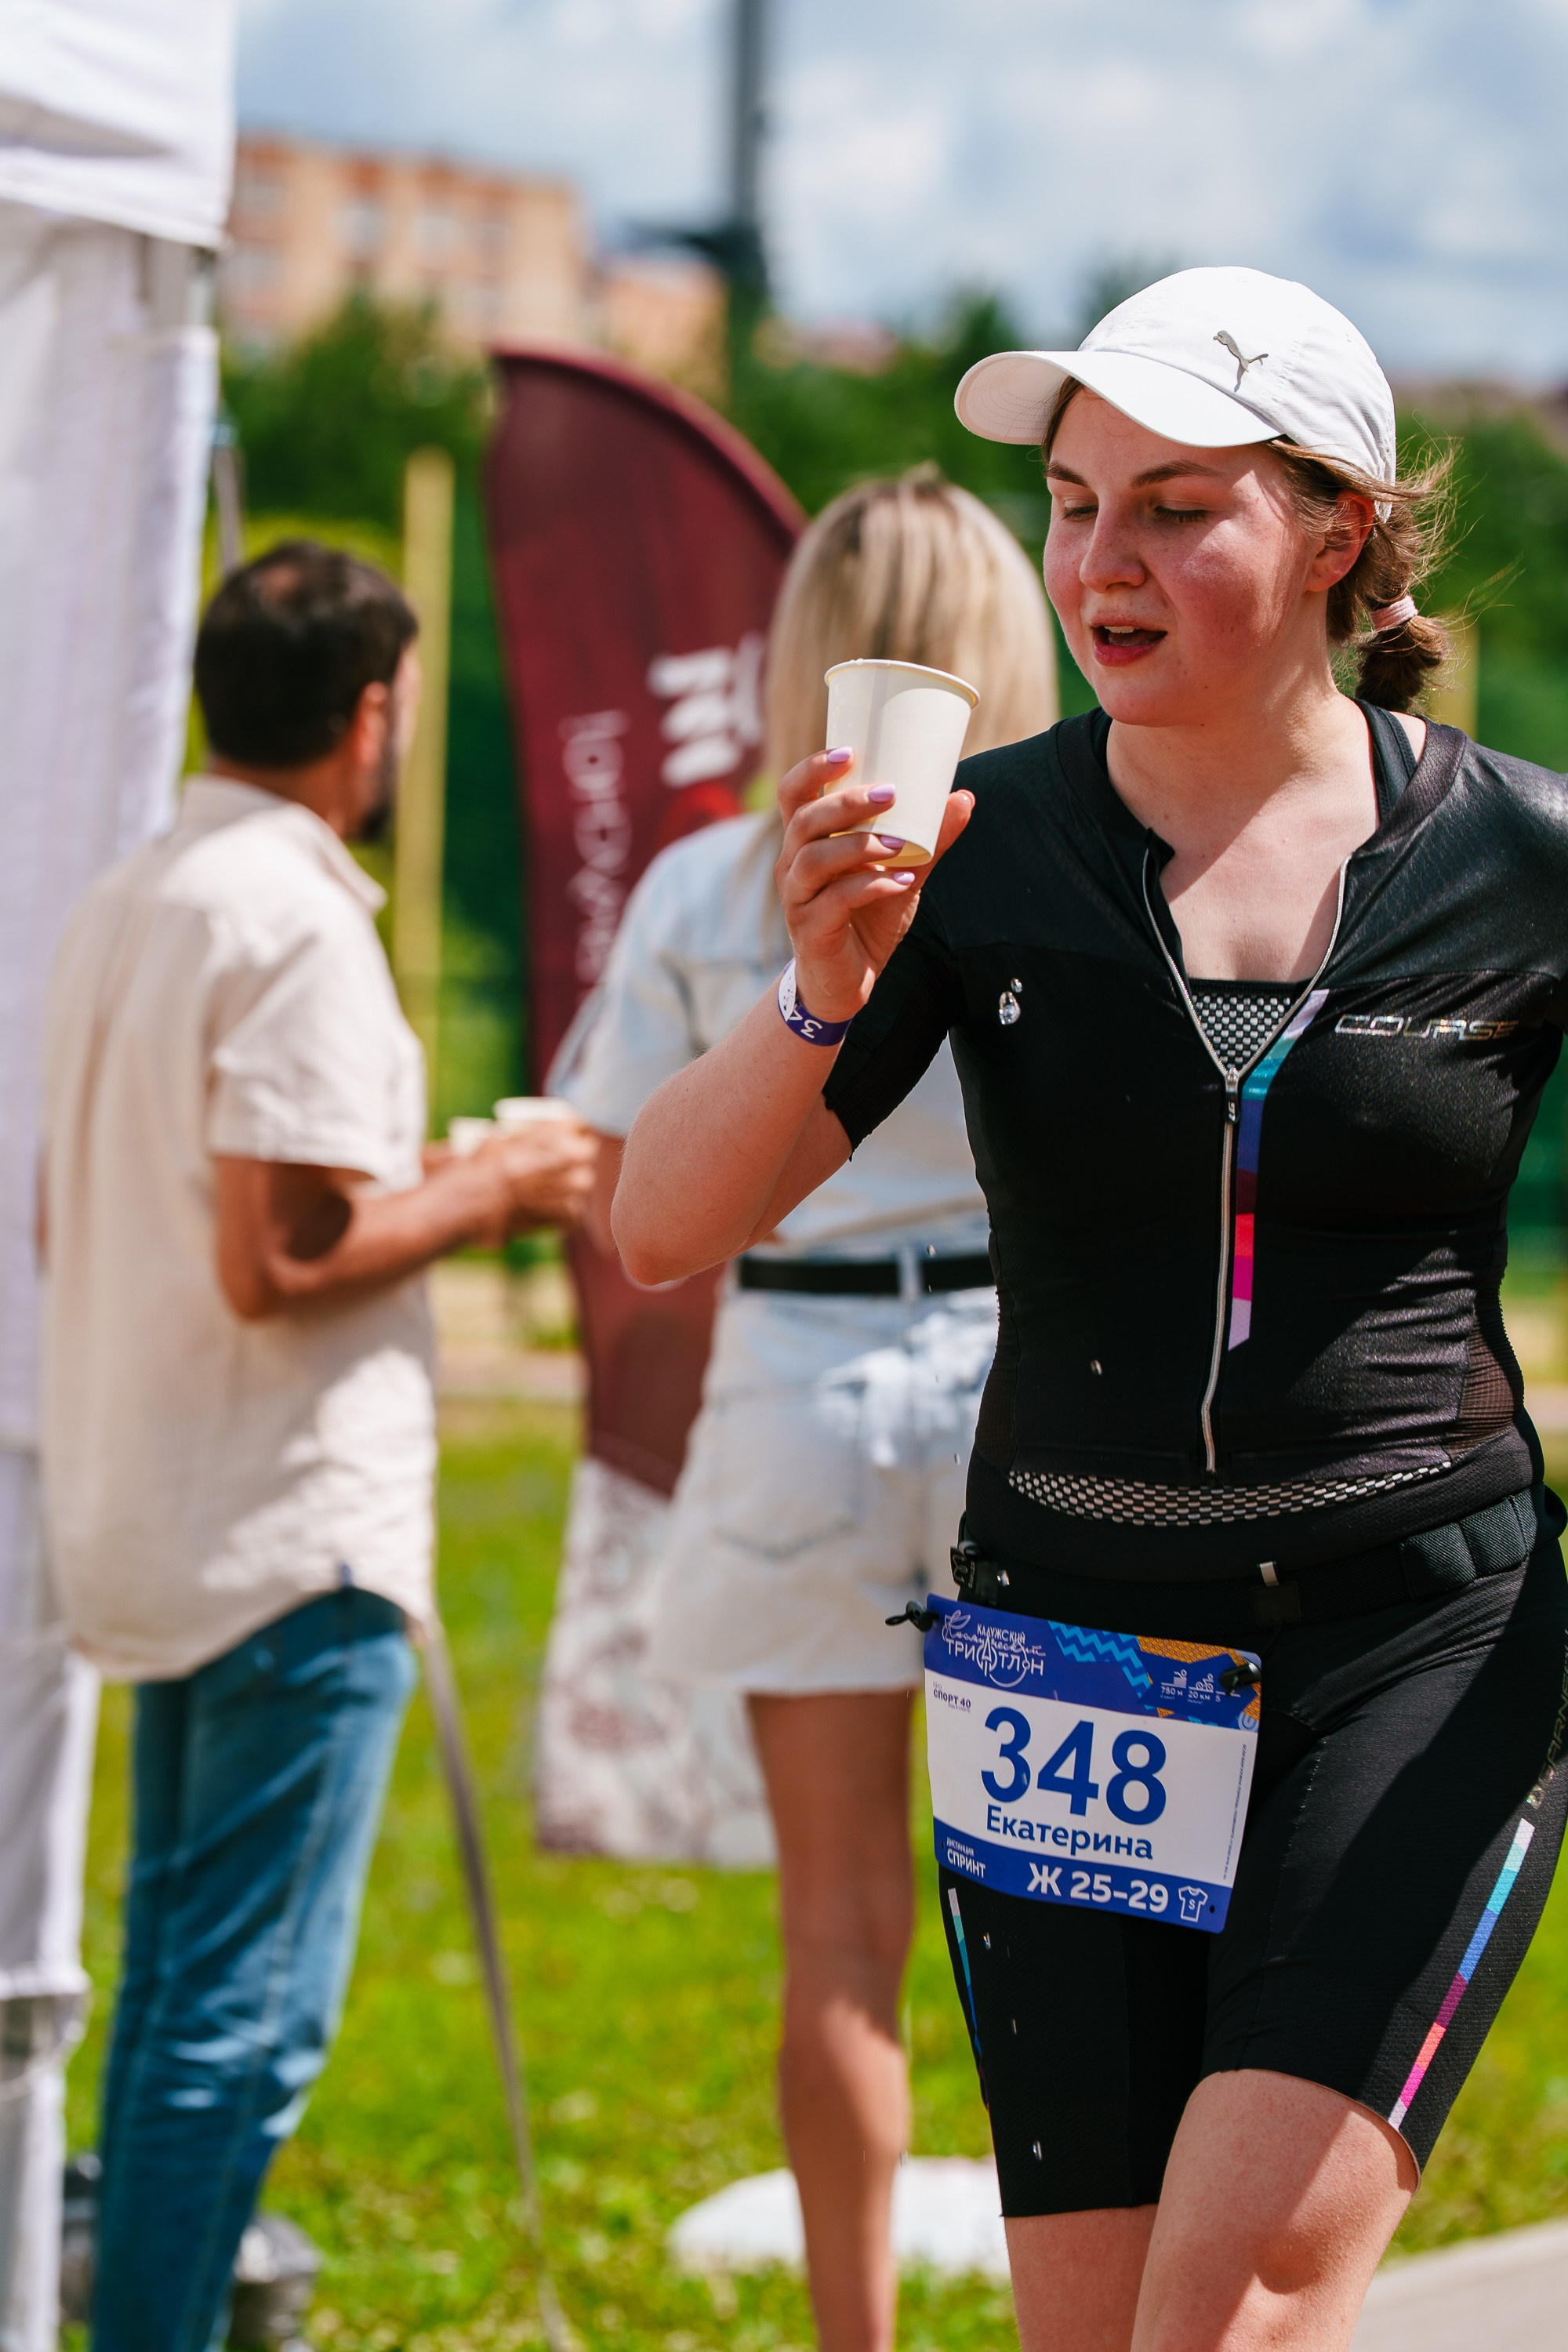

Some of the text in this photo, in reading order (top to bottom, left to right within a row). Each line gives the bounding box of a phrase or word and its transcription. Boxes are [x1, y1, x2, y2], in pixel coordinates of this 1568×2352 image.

[1334, 1014, 1519, 1041] COURSE
[977, 1623, 1025, 1645] КАЛУЖСКИЙ
[946, 1635, 1044, 1677] ТРИАТЛОН
[960, 1697, 971, 1709] 40
[981, 1706, 1167, 1825] 348
[986, 1803, 1153, 1860] Екатерина
[947, 1848, 986, 1878] СПРИНТ
[1026, 1862, 1169, 1914] Ж 25-29
[1186, 1898, 1196, 1911] S
